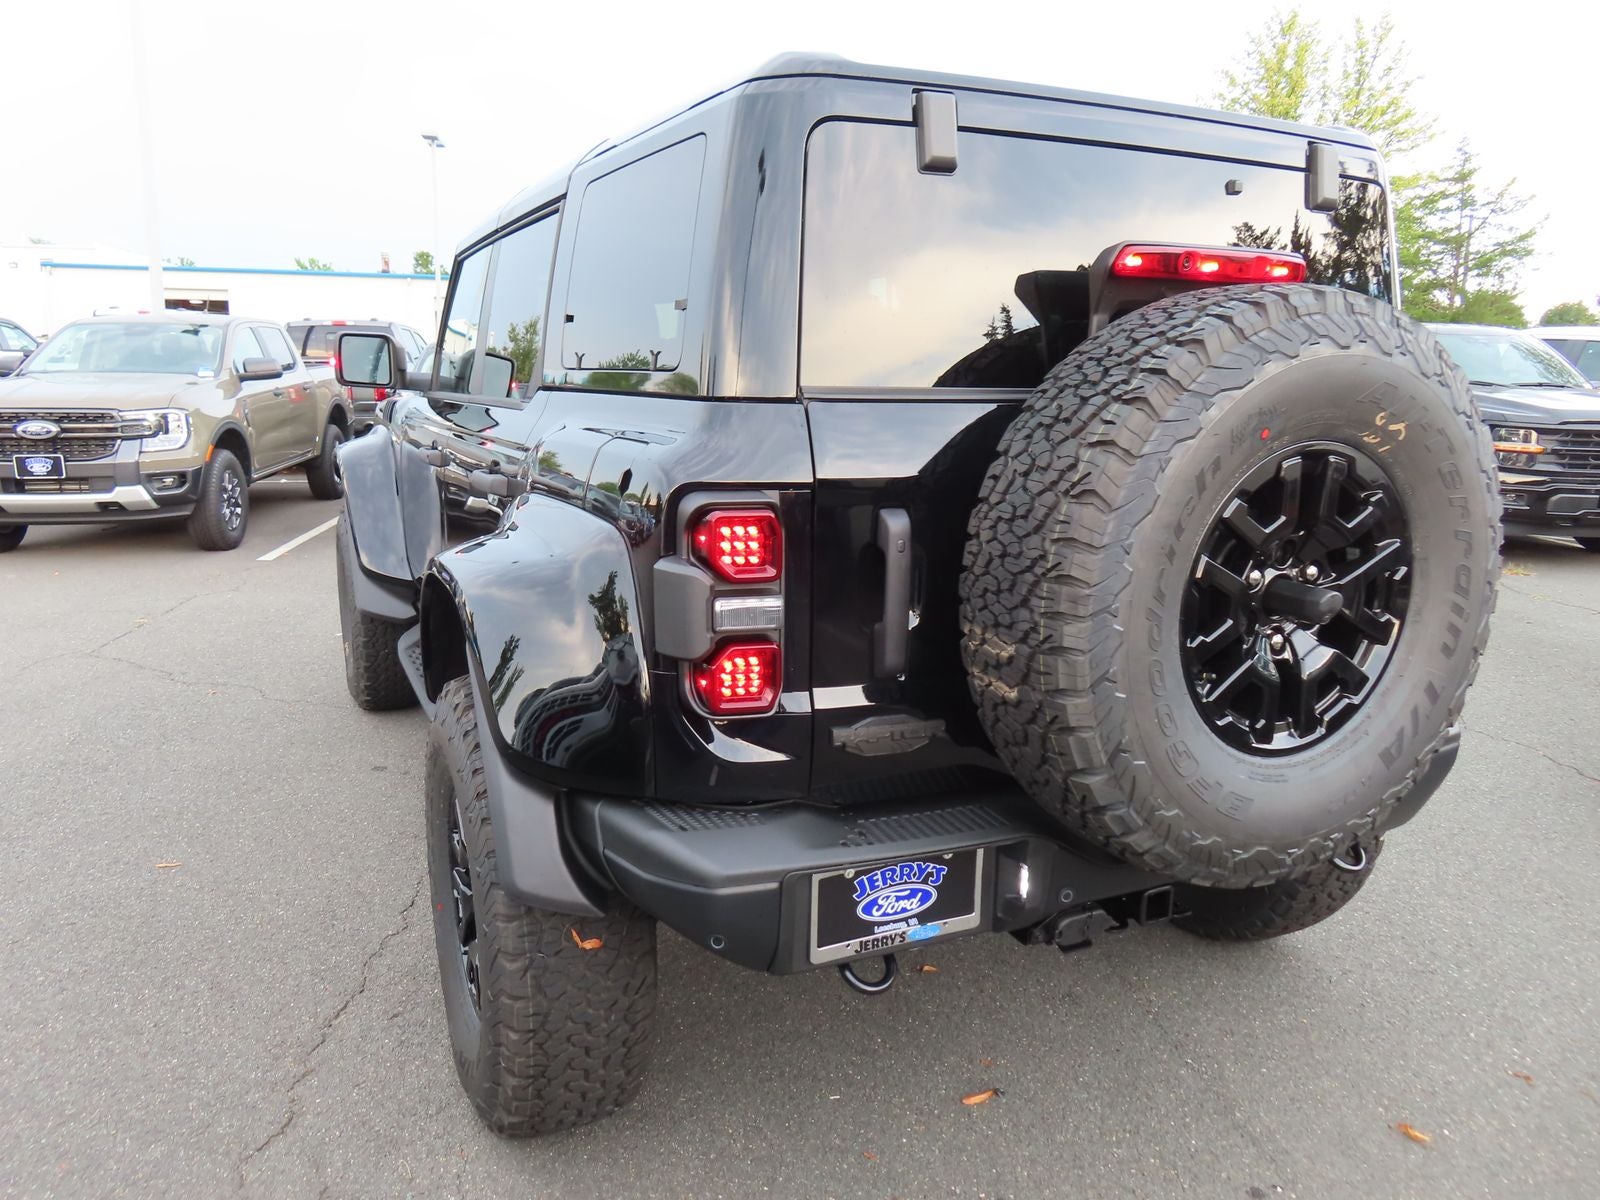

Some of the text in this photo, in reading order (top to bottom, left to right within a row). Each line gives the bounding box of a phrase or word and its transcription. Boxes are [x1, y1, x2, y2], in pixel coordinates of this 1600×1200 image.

[1145, 455, 1255, 822] BFGoodrich
[853, 862, 948, 901] JERRY'S
[871, 889, 922, 917] Ford
[854, 931, 906, 954] JERRY'S
